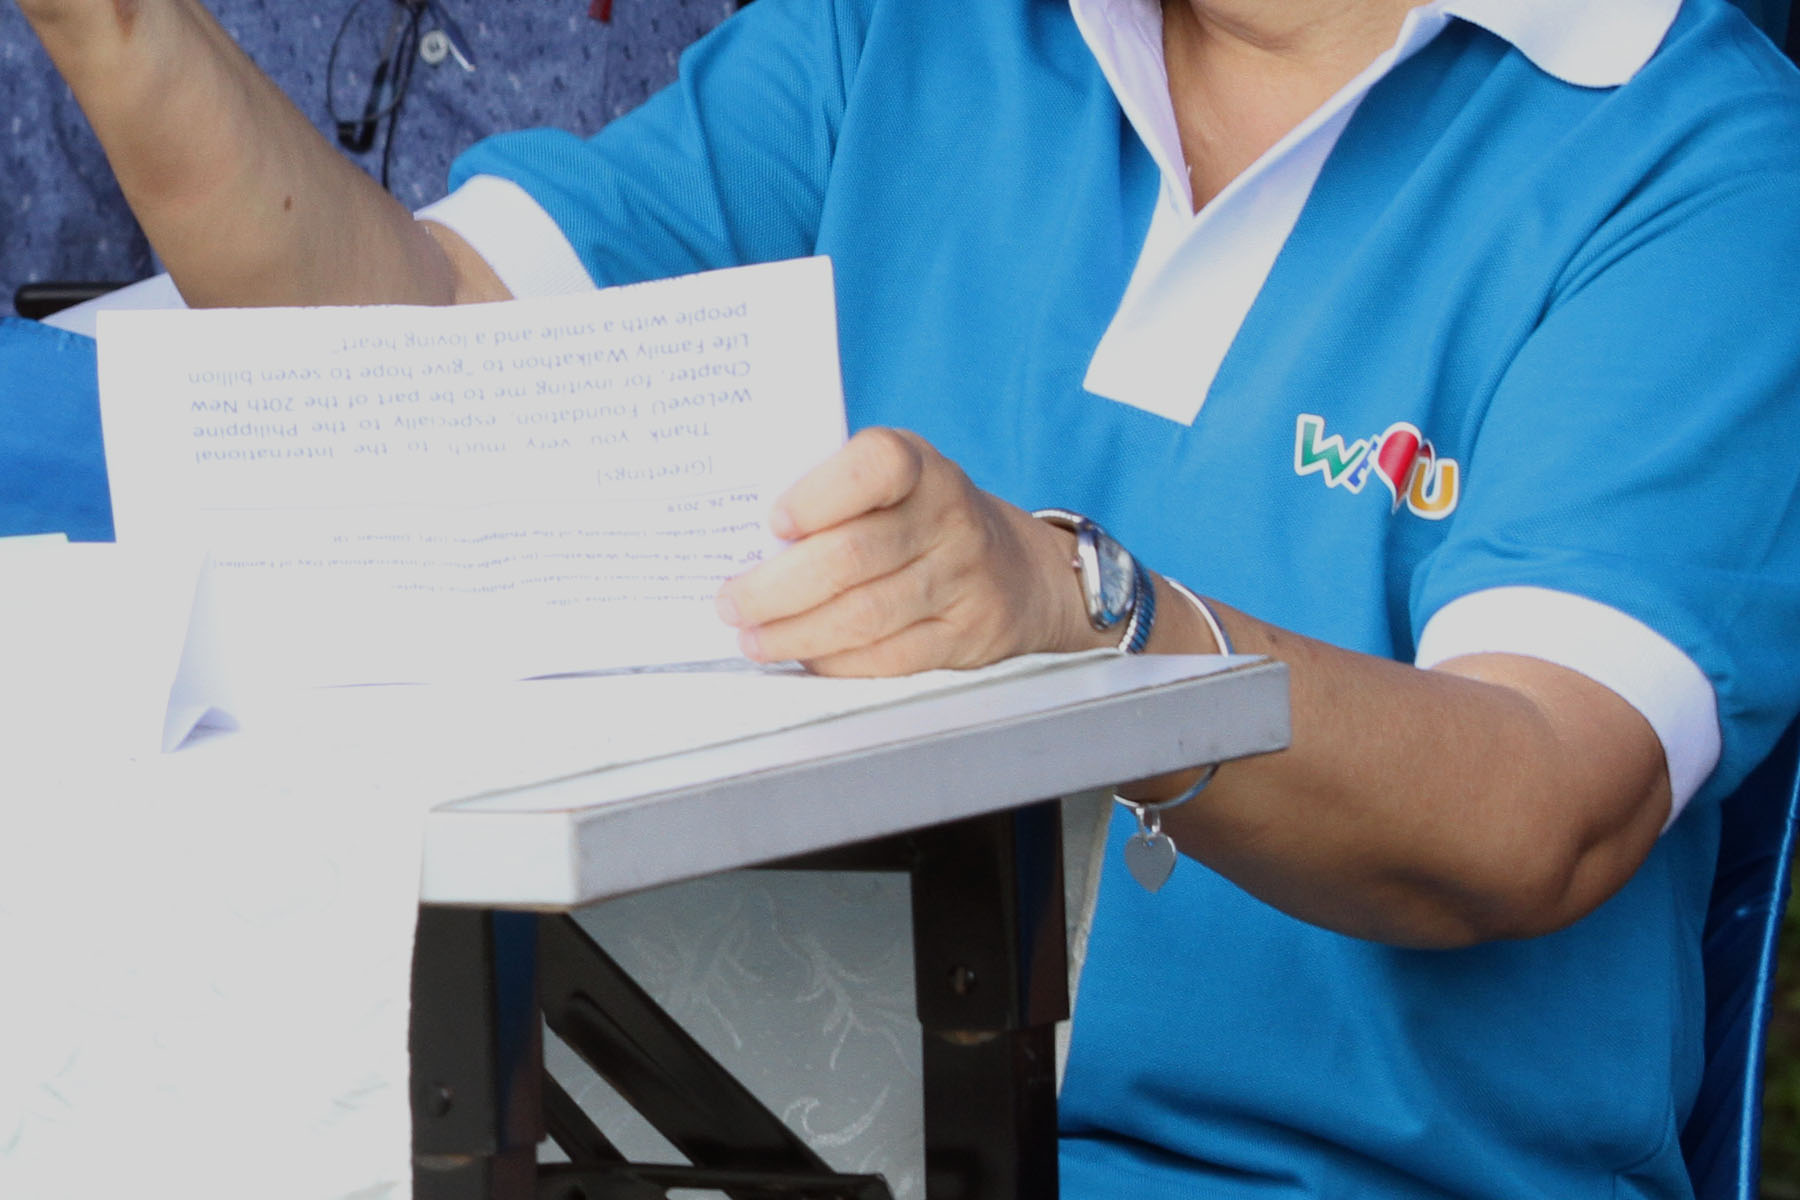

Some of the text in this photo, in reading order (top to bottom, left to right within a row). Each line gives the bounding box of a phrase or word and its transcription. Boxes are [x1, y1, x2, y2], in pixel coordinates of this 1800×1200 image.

[674, 302, 747, 327] people
[540, 322, 597, 344] smile
[603, 320, 615, 333] a
[621, 314, 668, 336] with
[402, 331, 468, 351] loving
[474, 331, 487, 345] a
[493, 328, 533, 349] and
[711, 331, 750, 354] Life
[512, 347, 629, 371] Walkathon
[637, 339, 704, 362] Family
[260, 367, 321, 383] seven
[329, 367, 352, 382] to
[359, 363, 413, 381] hope
[481, 359, 505, 373] to
[186, 369, 254, 389] billion
[535, 378, 613, 396] inviting
[623, 374, 653, 391] for
[348, 393, 369, 410] of
[377, 389, 421, 409] part
[429, 391, 456, 408] be
[463, 388, 485, 402] to
[494, 386, 528, 401] me
[191, 399, 239, 416] New
[247, 396, 297, 414] 20th
[303, 395, 339, 411] the
[191, 421, 299, 441] Philippine
[311, 420, 346, 436] the
[359, 419, 382, 434] to
[393, 413, 497, 431] especially
[194, 422, 712, 465] Thank you very much to the International
